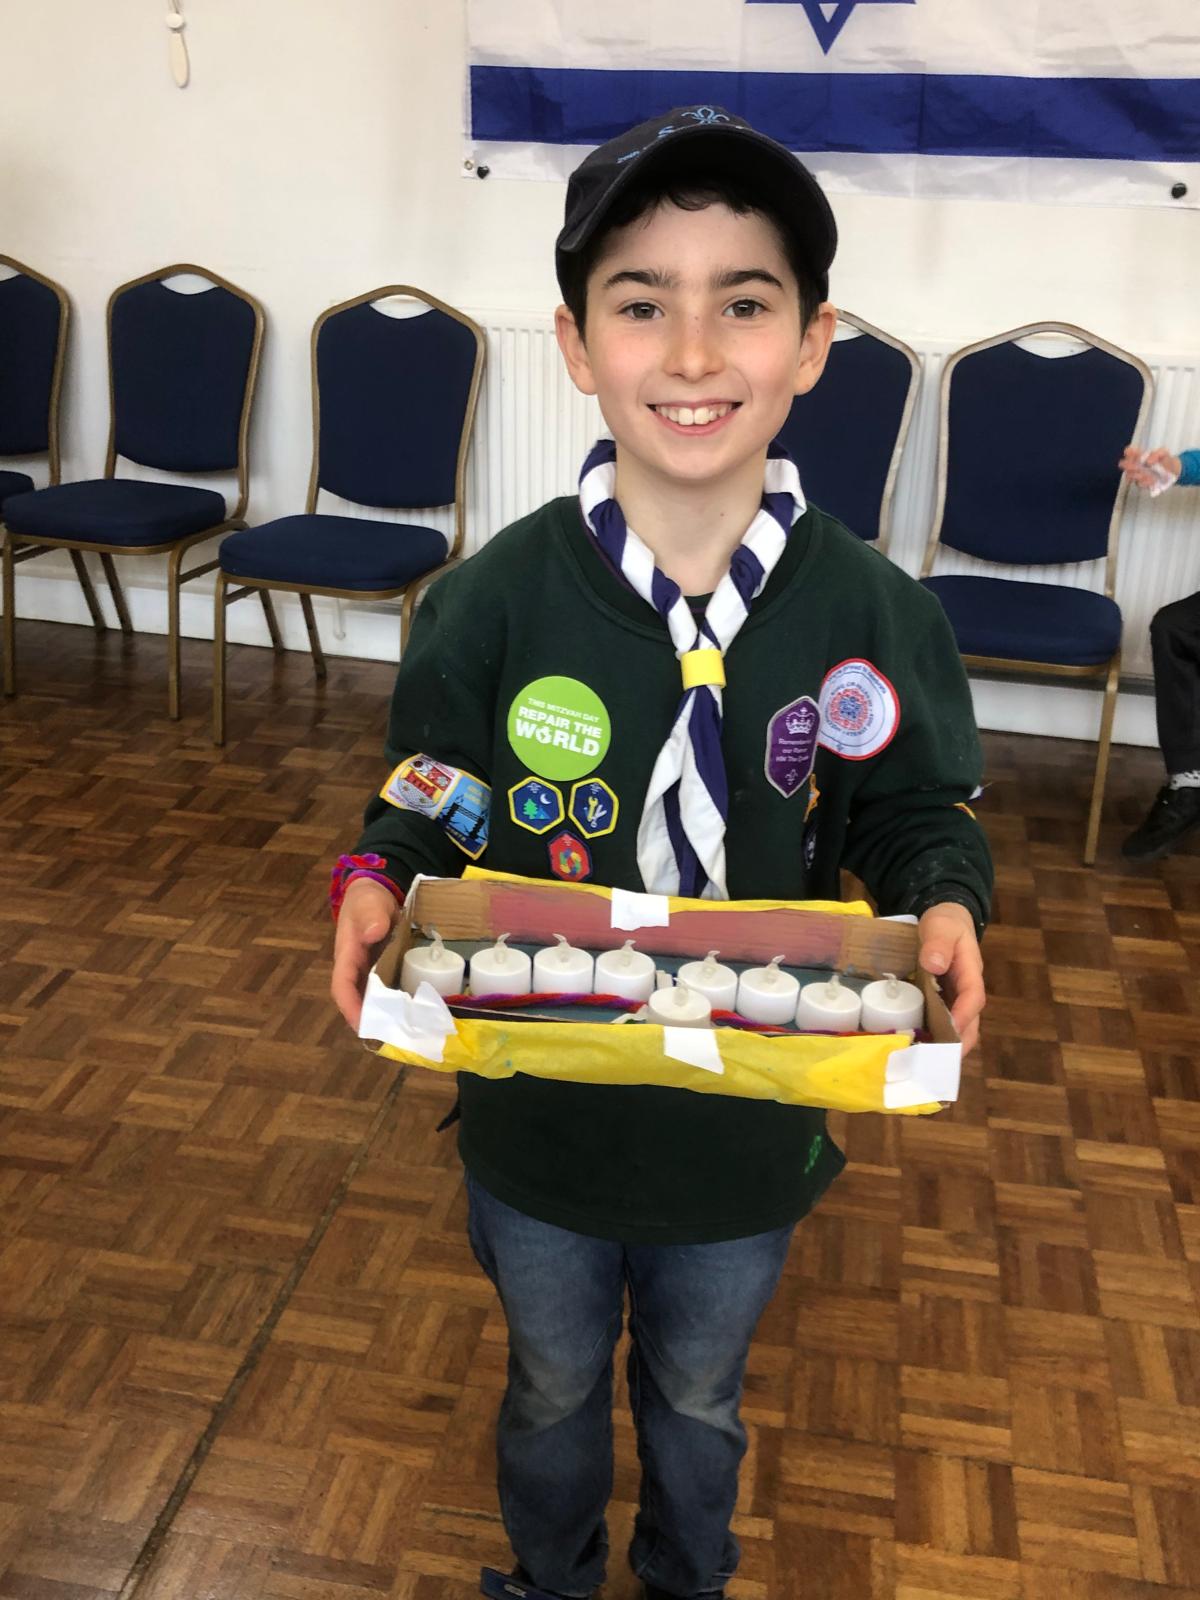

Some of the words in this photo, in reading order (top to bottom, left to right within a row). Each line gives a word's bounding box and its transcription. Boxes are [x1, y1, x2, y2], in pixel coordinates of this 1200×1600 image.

[516, 719, 600, 756] WORLD
[518, 706, 570, 730] REPAIR
[574, 721, 602, 739] THE
